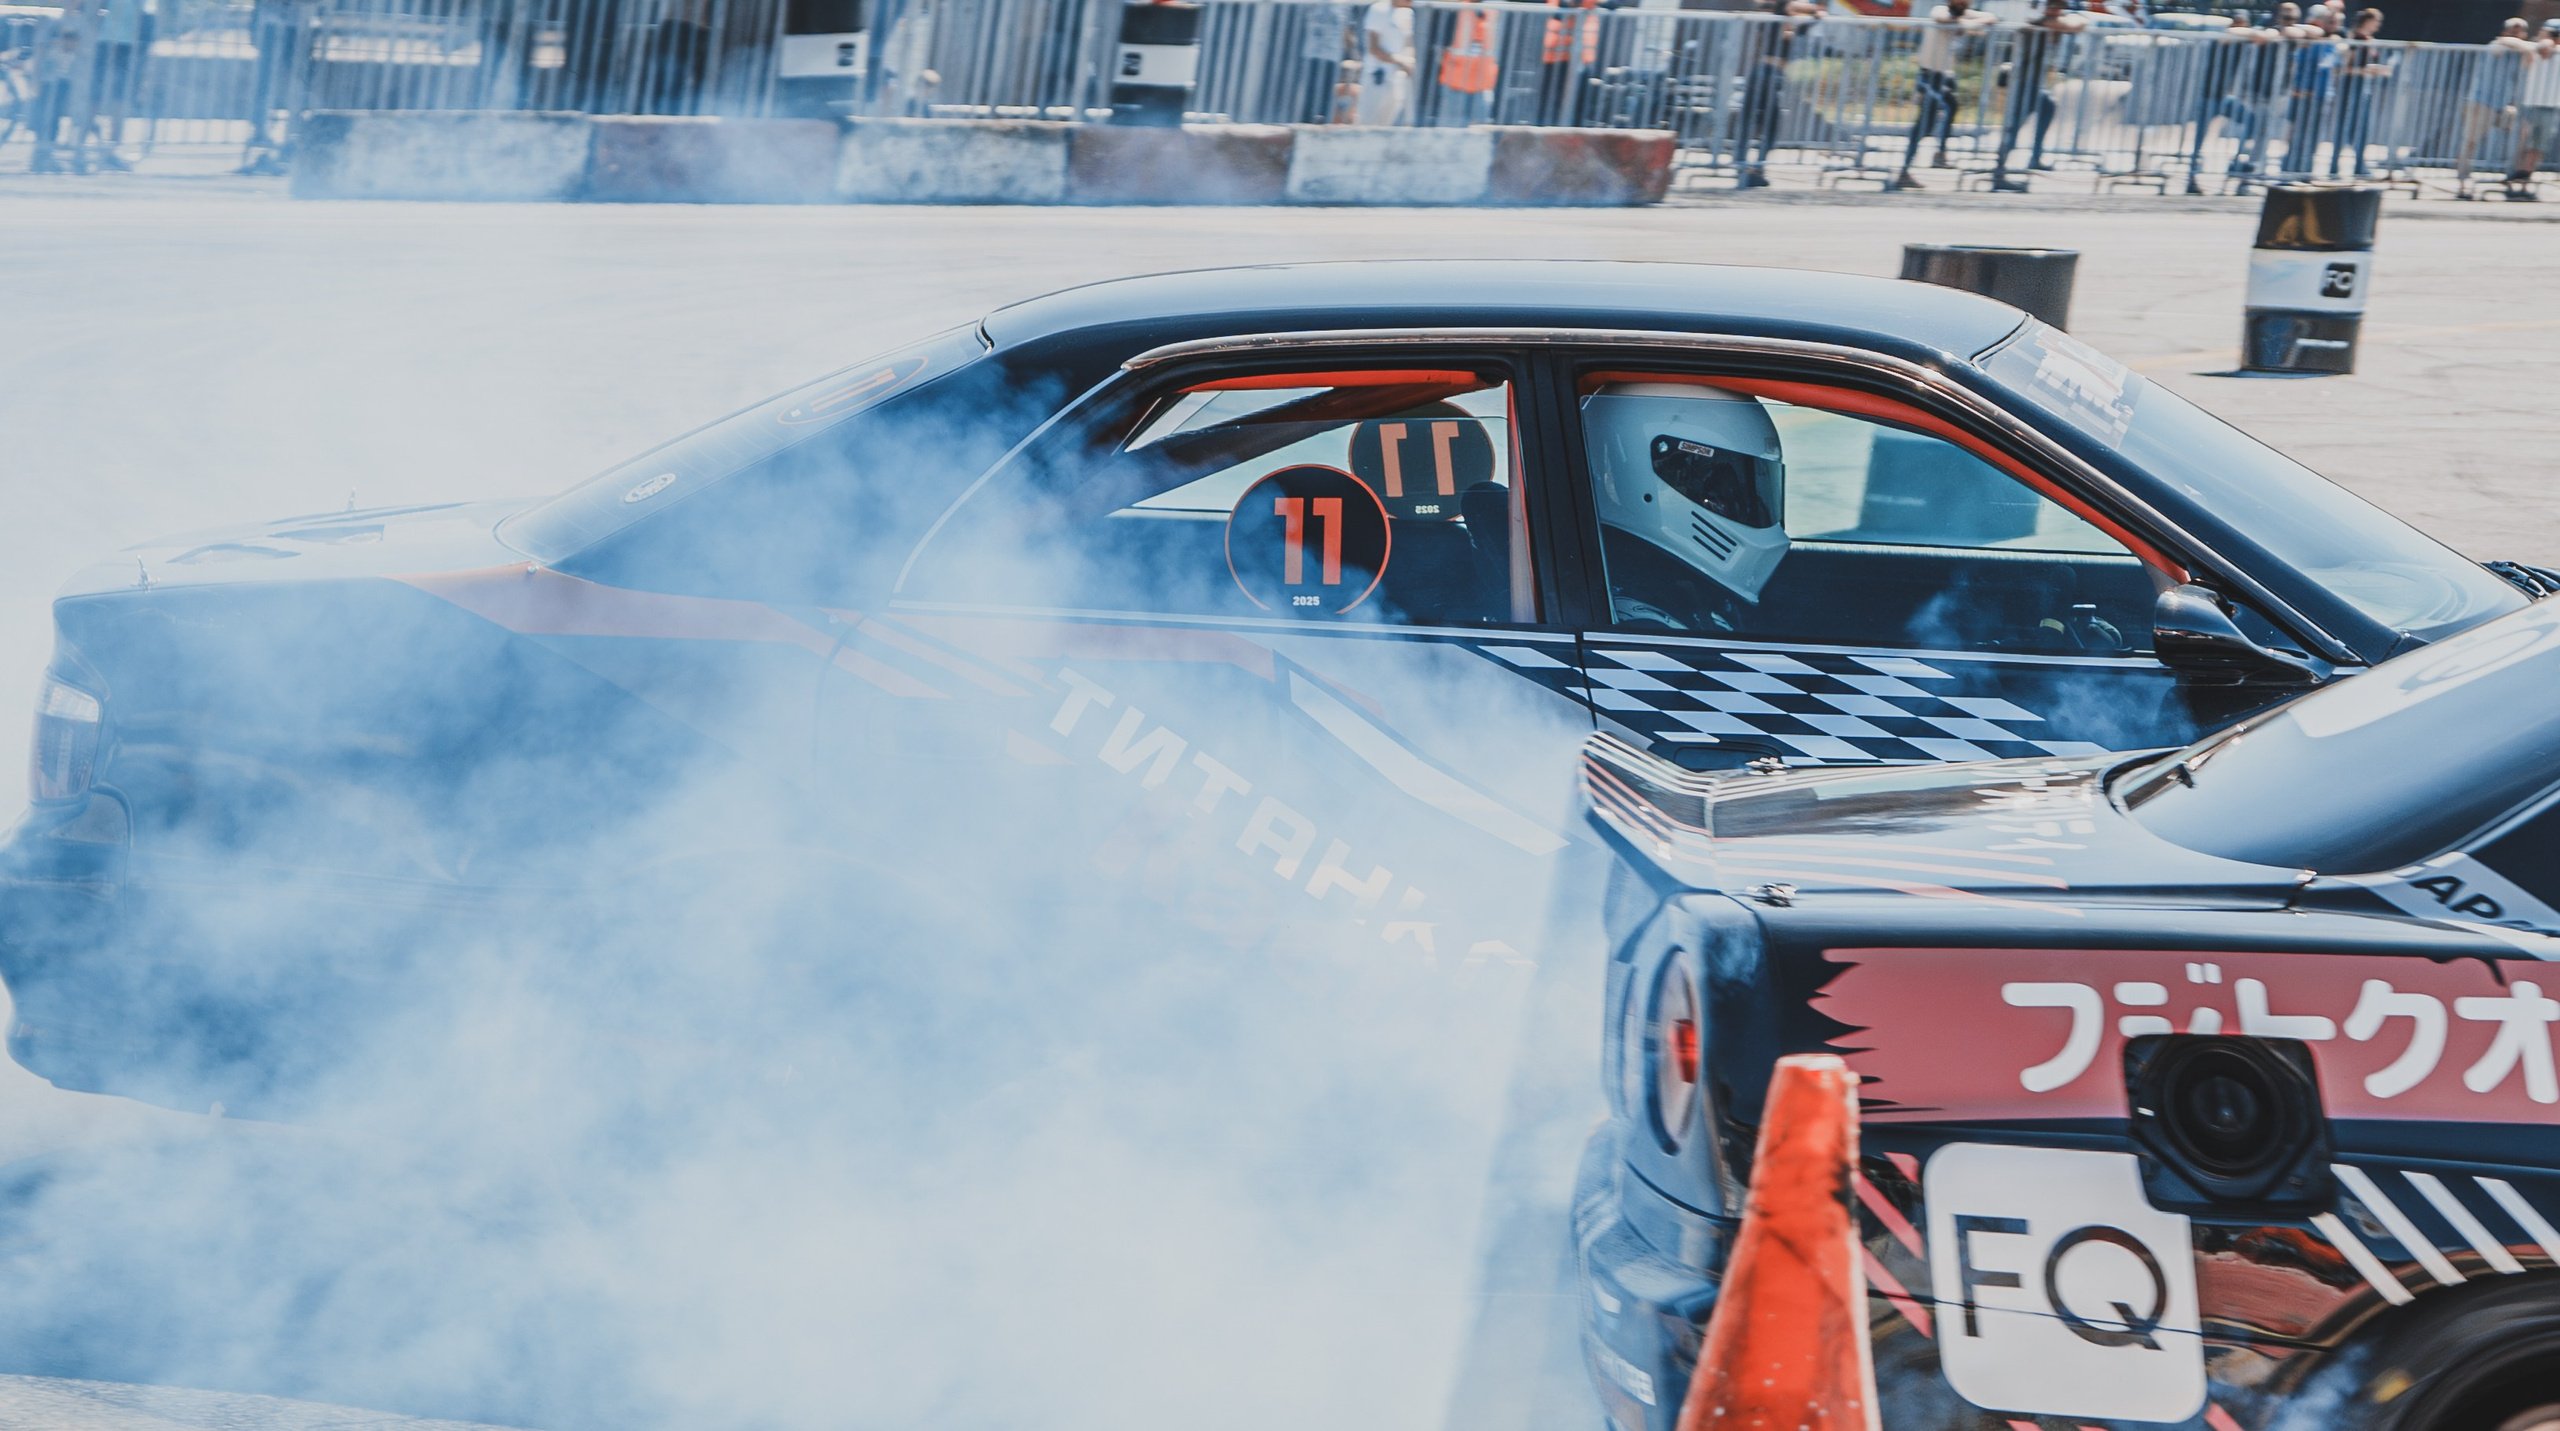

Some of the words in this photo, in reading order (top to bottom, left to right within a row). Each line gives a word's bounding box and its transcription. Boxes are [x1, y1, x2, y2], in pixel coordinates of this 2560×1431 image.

[1274, 497, 1343, 585] 11
[1292, 596, 1321, 607] 2025
[1952, 1214, 2166, 1351] FQ
